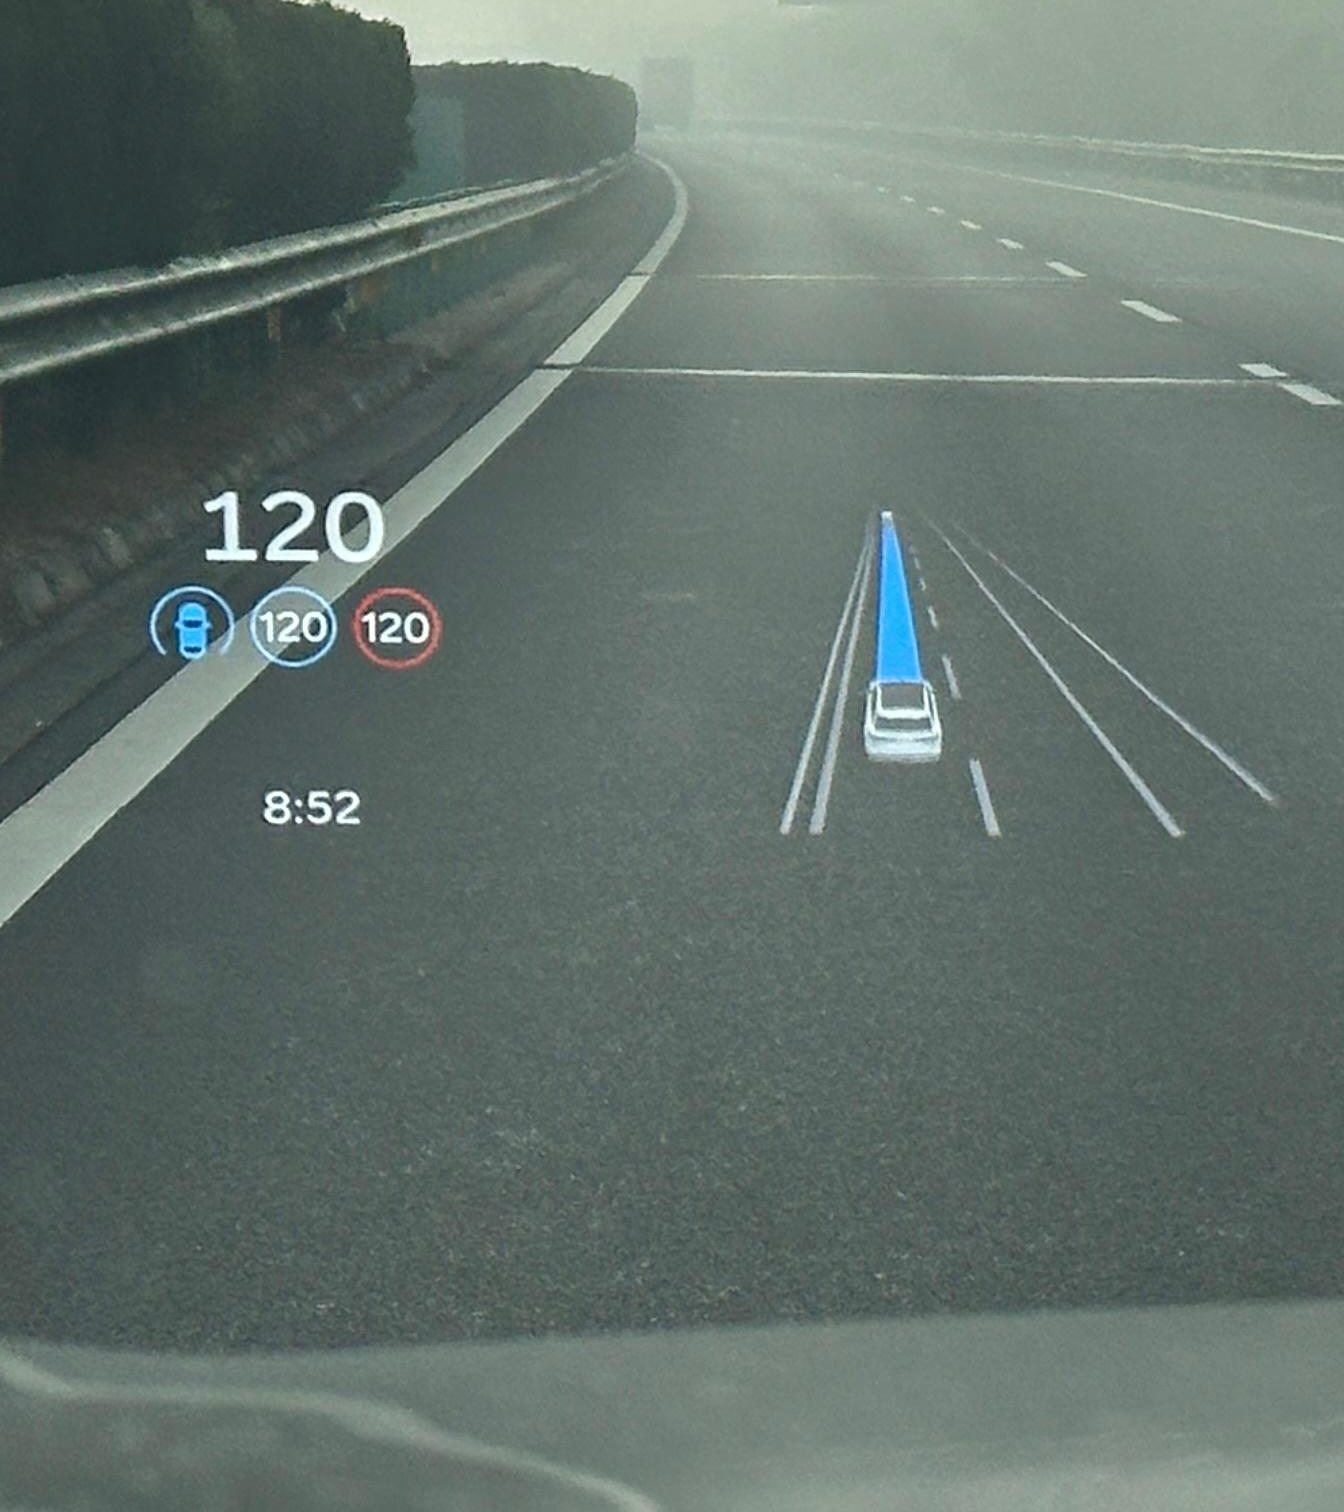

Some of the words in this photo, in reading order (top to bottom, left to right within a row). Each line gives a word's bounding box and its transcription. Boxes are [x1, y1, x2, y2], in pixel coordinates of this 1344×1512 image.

[203, 490, 385, 564] 120
[259, 610, 328, 644] 120
[361, 611, 430, 644] 120
[262, 789, 362, 825] 8:52
